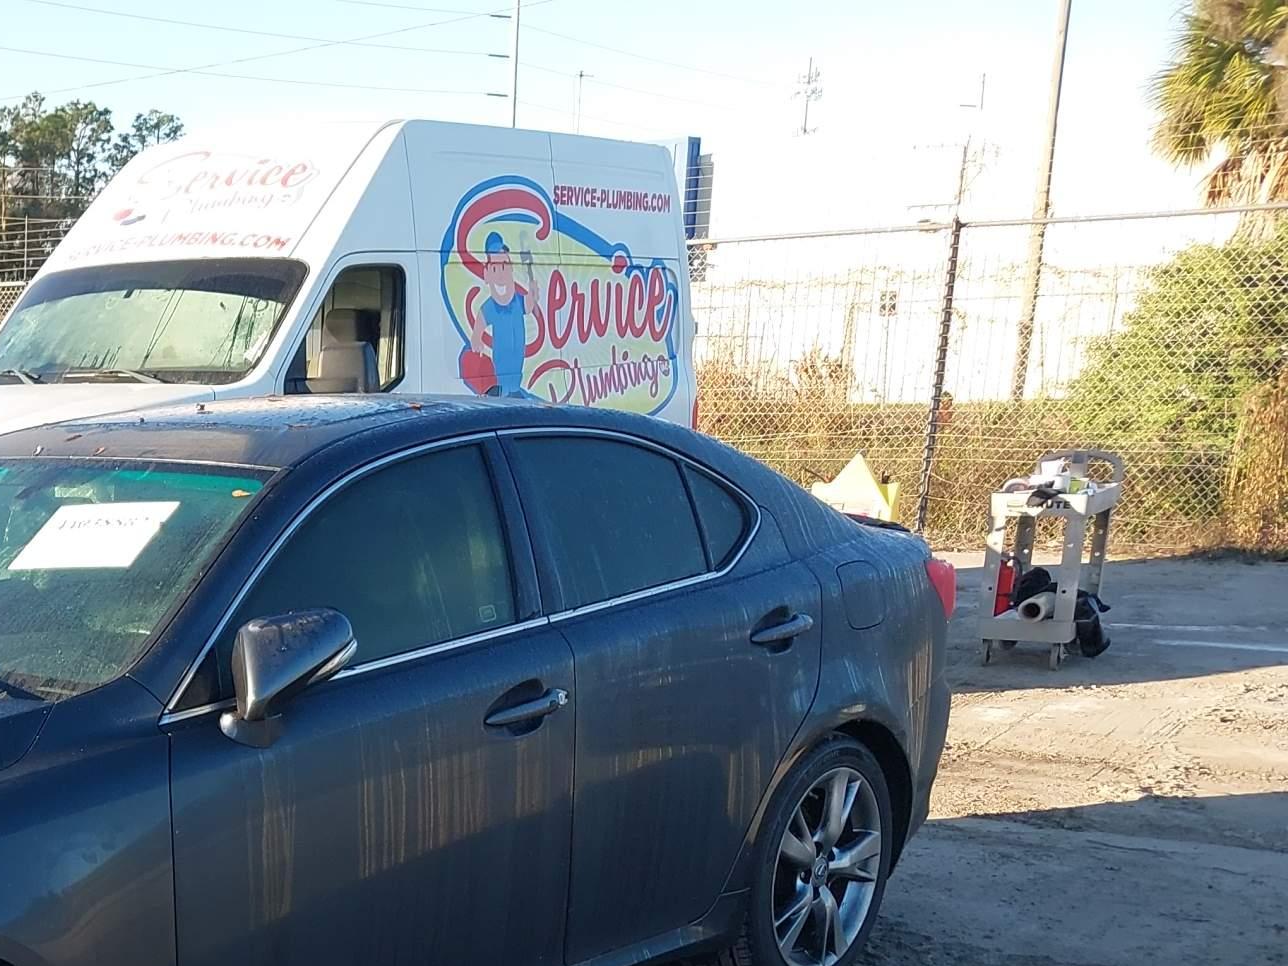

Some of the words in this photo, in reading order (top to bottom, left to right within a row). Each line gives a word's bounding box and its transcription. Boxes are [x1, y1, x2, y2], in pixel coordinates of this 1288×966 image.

[137, 151, 315, 200] Service
[553, 185, 671, 213] SERVICE-PLUMBING.COM
[457, 188, 673, 358] Service
[528, 345, 662, 405] Plumbing
